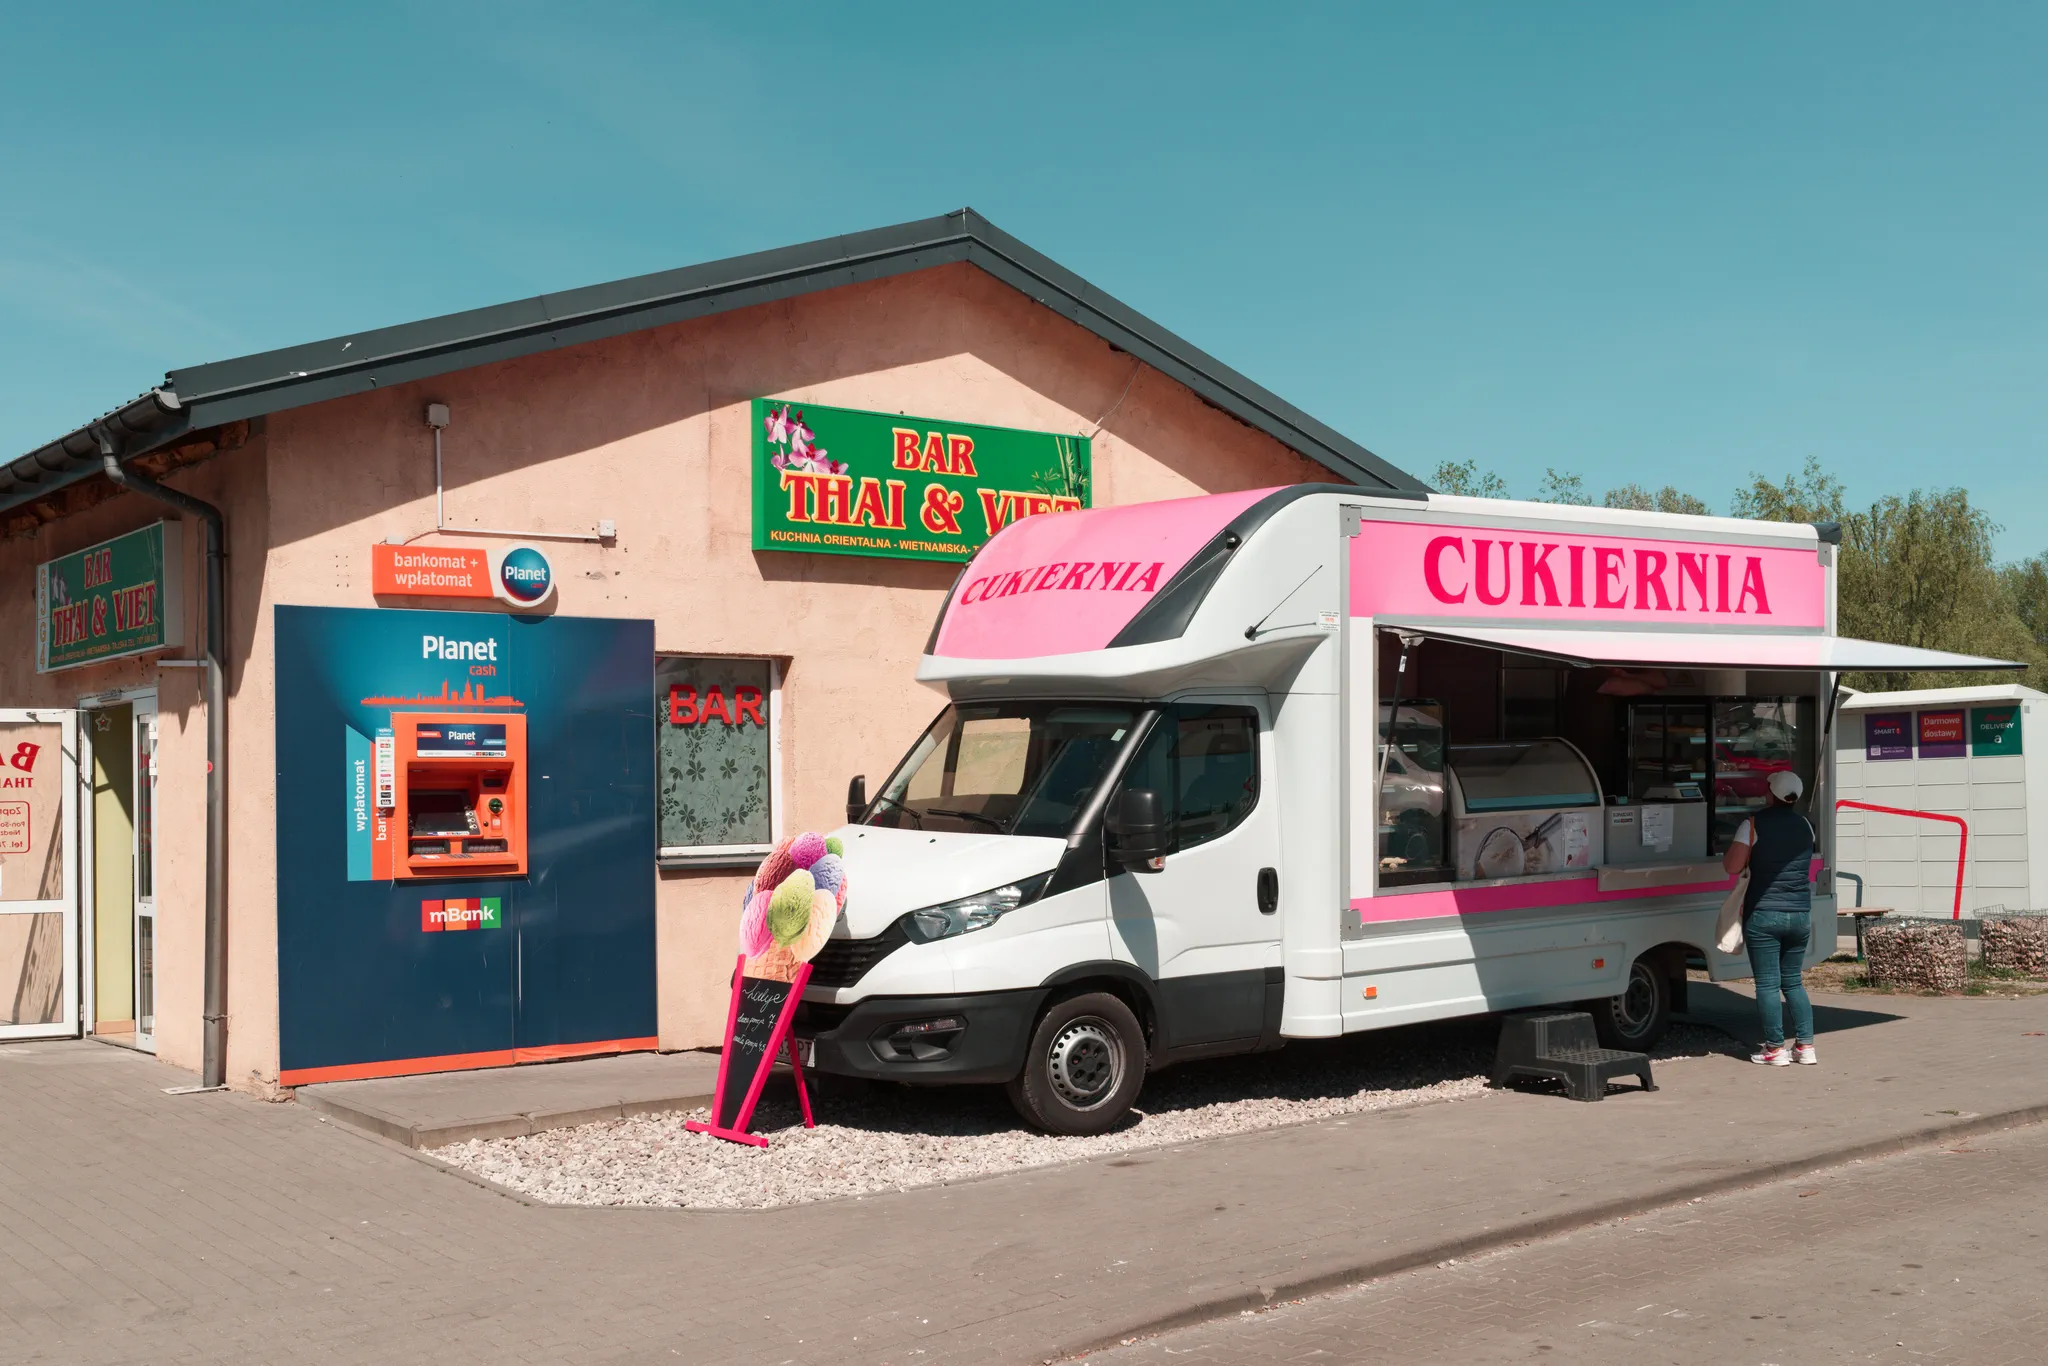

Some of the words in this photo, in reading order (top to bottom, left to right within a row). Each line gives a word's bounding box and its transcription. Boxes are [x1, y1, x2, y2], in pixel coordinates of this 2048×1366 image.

[892, 427, 978, 477] BAR
[780, 470, 906, 530] THAI
[920, 483, 964, 534] &
[770, 530, 822, 544] KUCHNIA
[823, 534, 892, 549] ORIENTALNA
[84, 548, 112, 589] BAR
[394, 552, 466, 569] bankomat
[395, 570, 473, 588] wpłatomat
[505, 566, 547, 581] Planet
[959, 561, 1165, 606] CUKIERNIA
[1422, 535, 1773, 616] CUKIERNIA
[52, 599, 88, 648] THAI
[92, 594, 107, 638] &
[112, 580, 156, 632] VIET
[423, 635, 497, 661] Planet
[469, 664, 496, 676] cash
[670, 683, 765, 725] BAR
[1923, 717, 1960, 726] Darmowe
[1980, 722, 2014, 730] DELIVERY
[448, 731, 476, 740] Planet
[1924, 730, 1957, 739] dostawy
[354, 760, 368, 832] wpłatomat
[376, 807, 387, 840] bank
[429, 906, 495, 923] mBank
